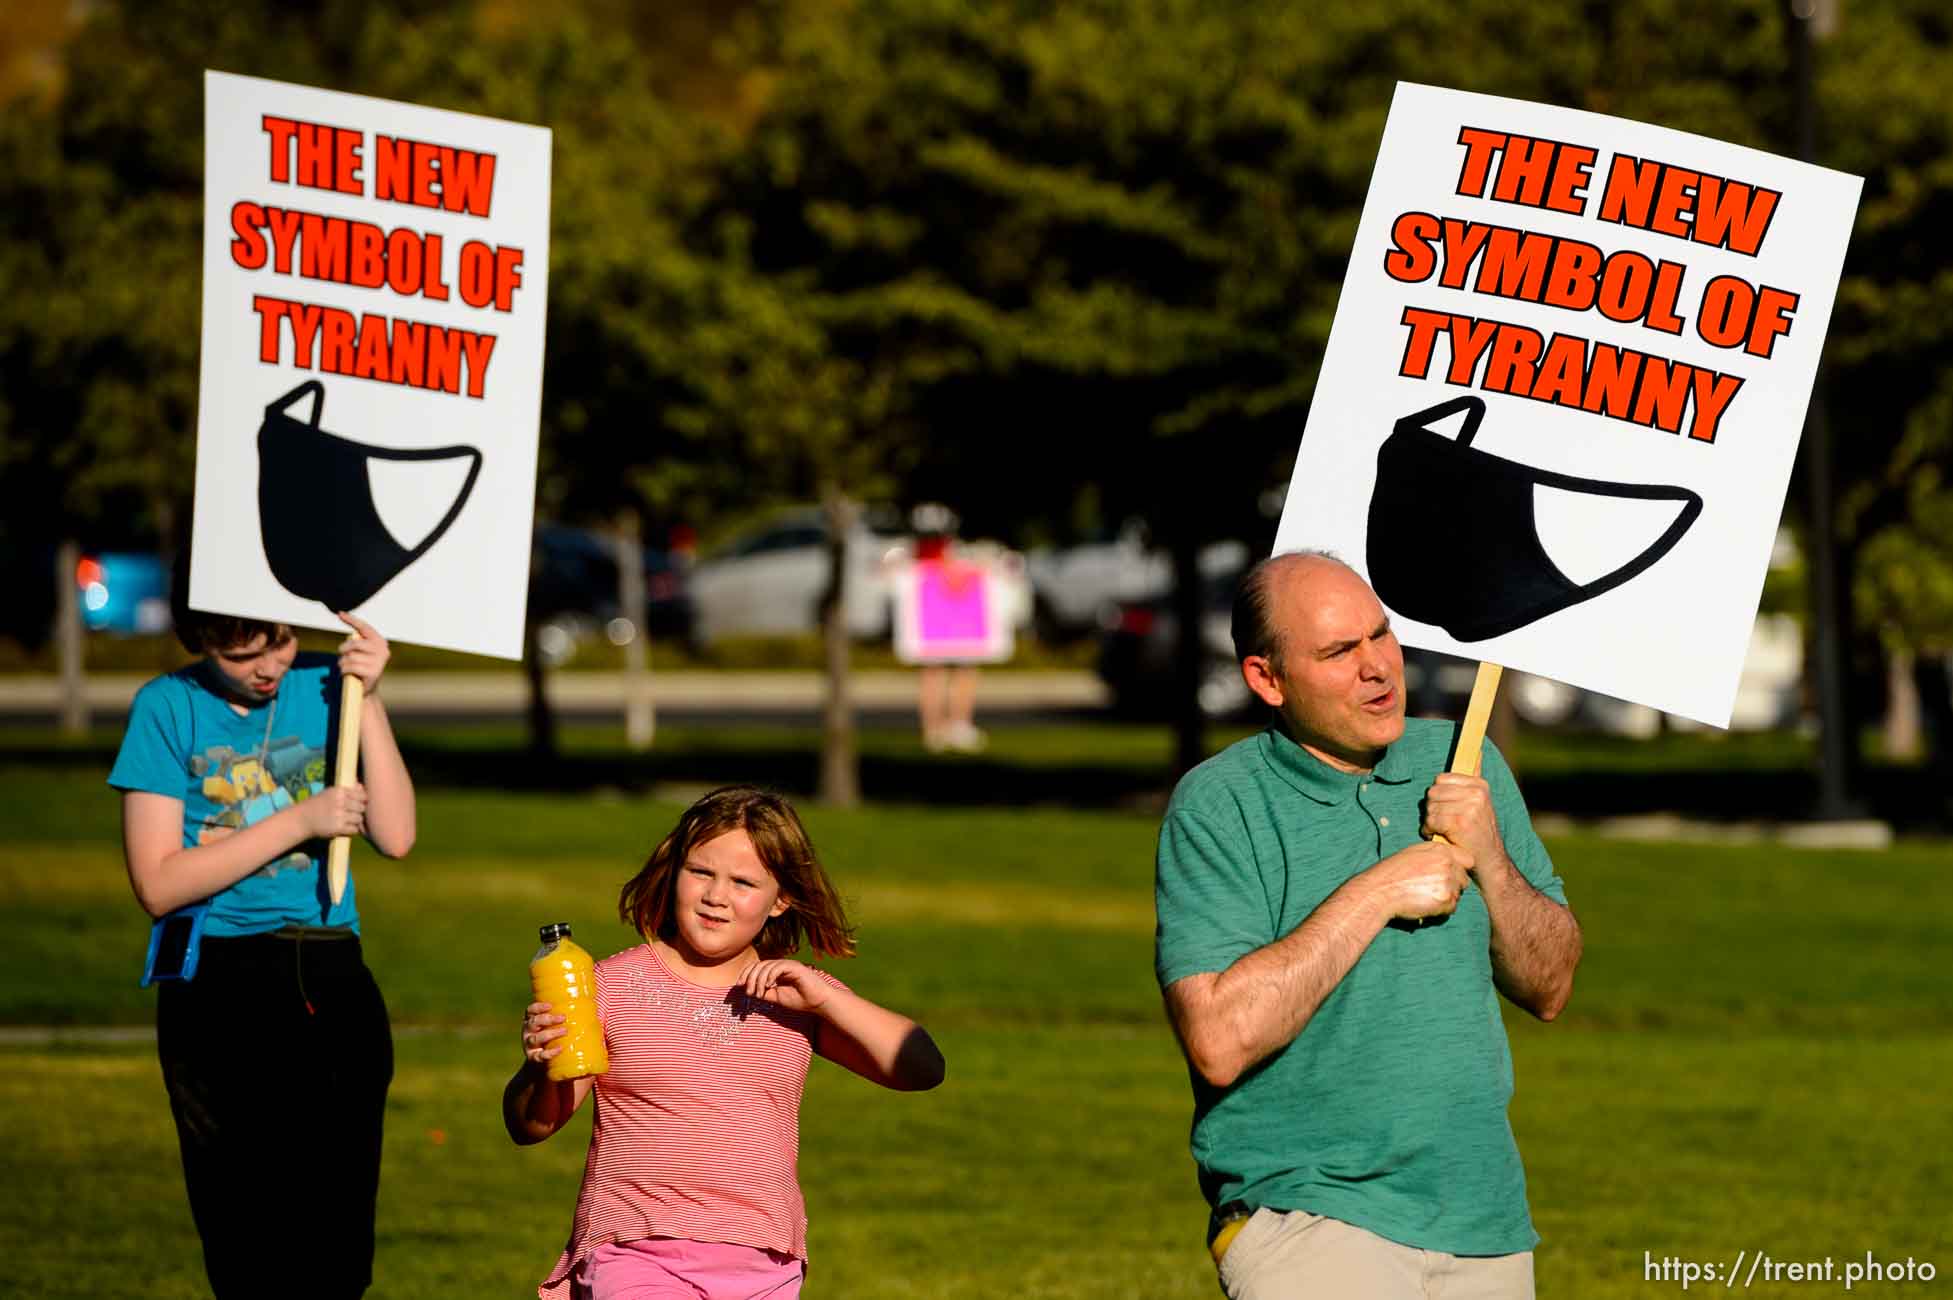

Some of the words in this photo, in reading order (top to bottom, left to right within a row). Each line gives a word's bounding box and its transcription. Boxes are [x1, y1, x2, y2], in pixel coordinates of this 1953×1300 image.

[262, 114, 364, 196] THE
[375, 133, 497, 218] NEW
[1456, 126, 1599, 216] THE
[1599, 152, 1783, 257] NEW
[230, 201, 450, 302] SYMBOL
[458, 240, 524, 313] OF
[1384, 211, 1687, 336] SYMBOL
[1696, 275, 1800, 360] OF
[253, 294, 498, 400] TYRANNY
[1398, 305, 1747, 444] TYRANNY
